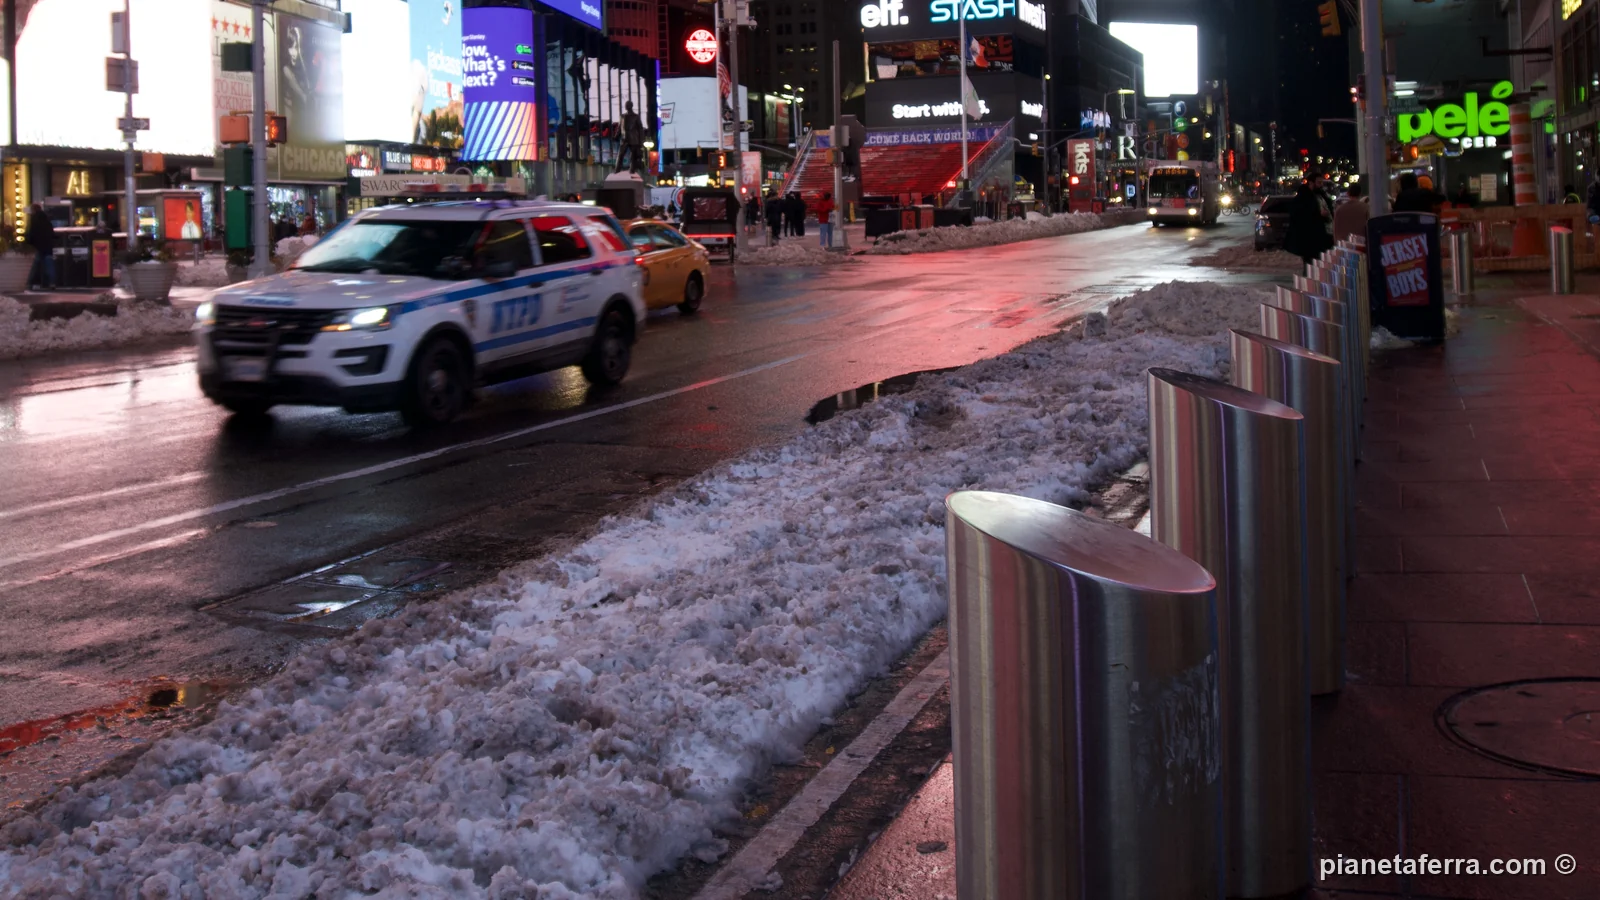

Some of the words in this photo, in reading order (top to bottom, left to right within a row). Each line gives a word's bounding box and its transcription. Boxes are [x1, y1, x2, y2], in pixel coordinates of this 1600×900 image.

[930, 0, 1016, 23] STASH
[214, 78, 229, 94] TO
[892, 103, 930, 119] Start
[931, 101, 963, 117] with
[1397, 80, 1514, 143] pelé
[902, 129, 931, 144] BACK
[1118, 136, 1137, 160] R
[284, 147, 345, 173] CHICAGO
[1074, 142, 1091, 175] tkts
[66, 170, 91, 195] AE
[1380, 233, 1429, 267] JERSEY
[1387, 267, 1428, 298] BOYS
